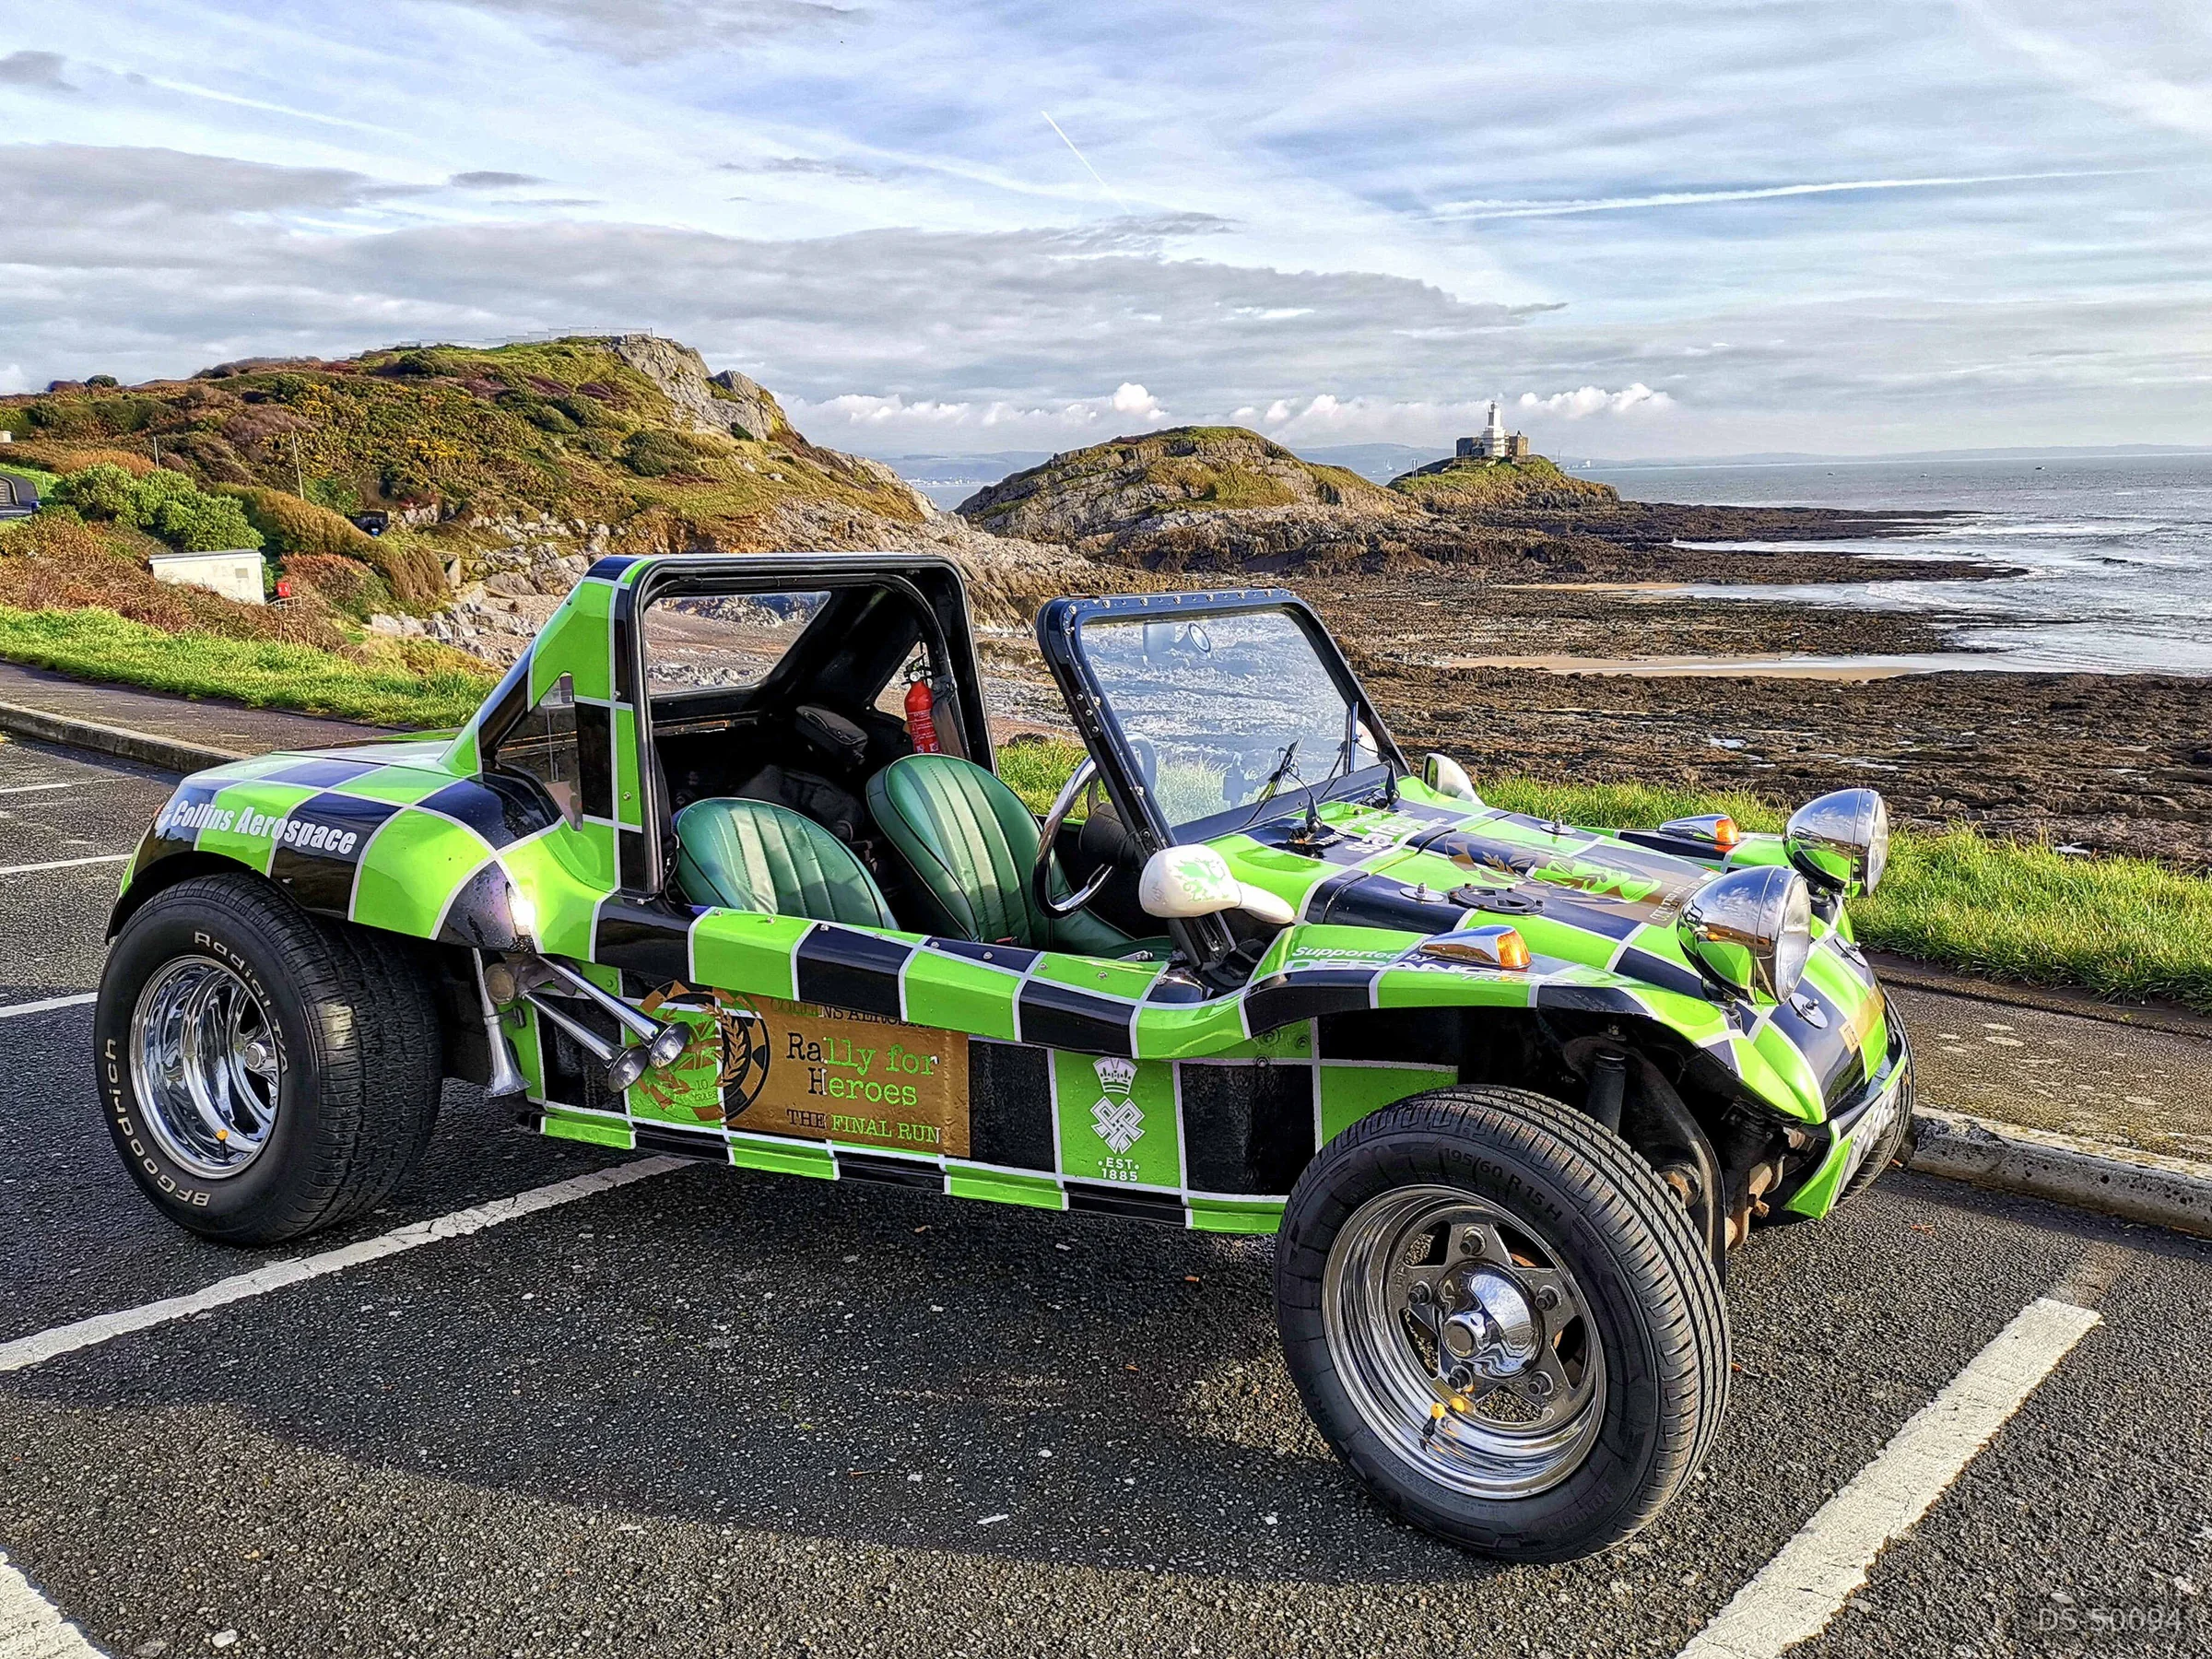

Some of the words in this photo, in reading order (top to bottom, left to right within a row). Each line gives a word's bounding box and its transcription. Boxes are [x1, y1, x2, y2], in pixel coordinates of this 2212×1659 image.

[171, 800, 234, 830] Collins
[233, 806, 358, 855] Aerospace
[194, 931, 272, 1007] Radial
[1292, 947, 1405, 960] Supported
[1406, 953, 1435, 963] by
[786, 1032, 877, 1075] Rally
[886, 1043, 940, 1076] for
[808, 1067, 918, 1106] Heroes
[105, 1038, 212, 1207] BFGoodrich
[786, 1109, 828, 1129] THE
[831, 1114, 894, 1138] FINAL
[897, 1122, 941, 1144] RUN
[1101, 1169, 1139, 1182] 1885
[1507, 1173, 1524, 1191] R
[1526, 1185, 1547, 1206] 15
[1544, 1201, 1565, 1222] H
